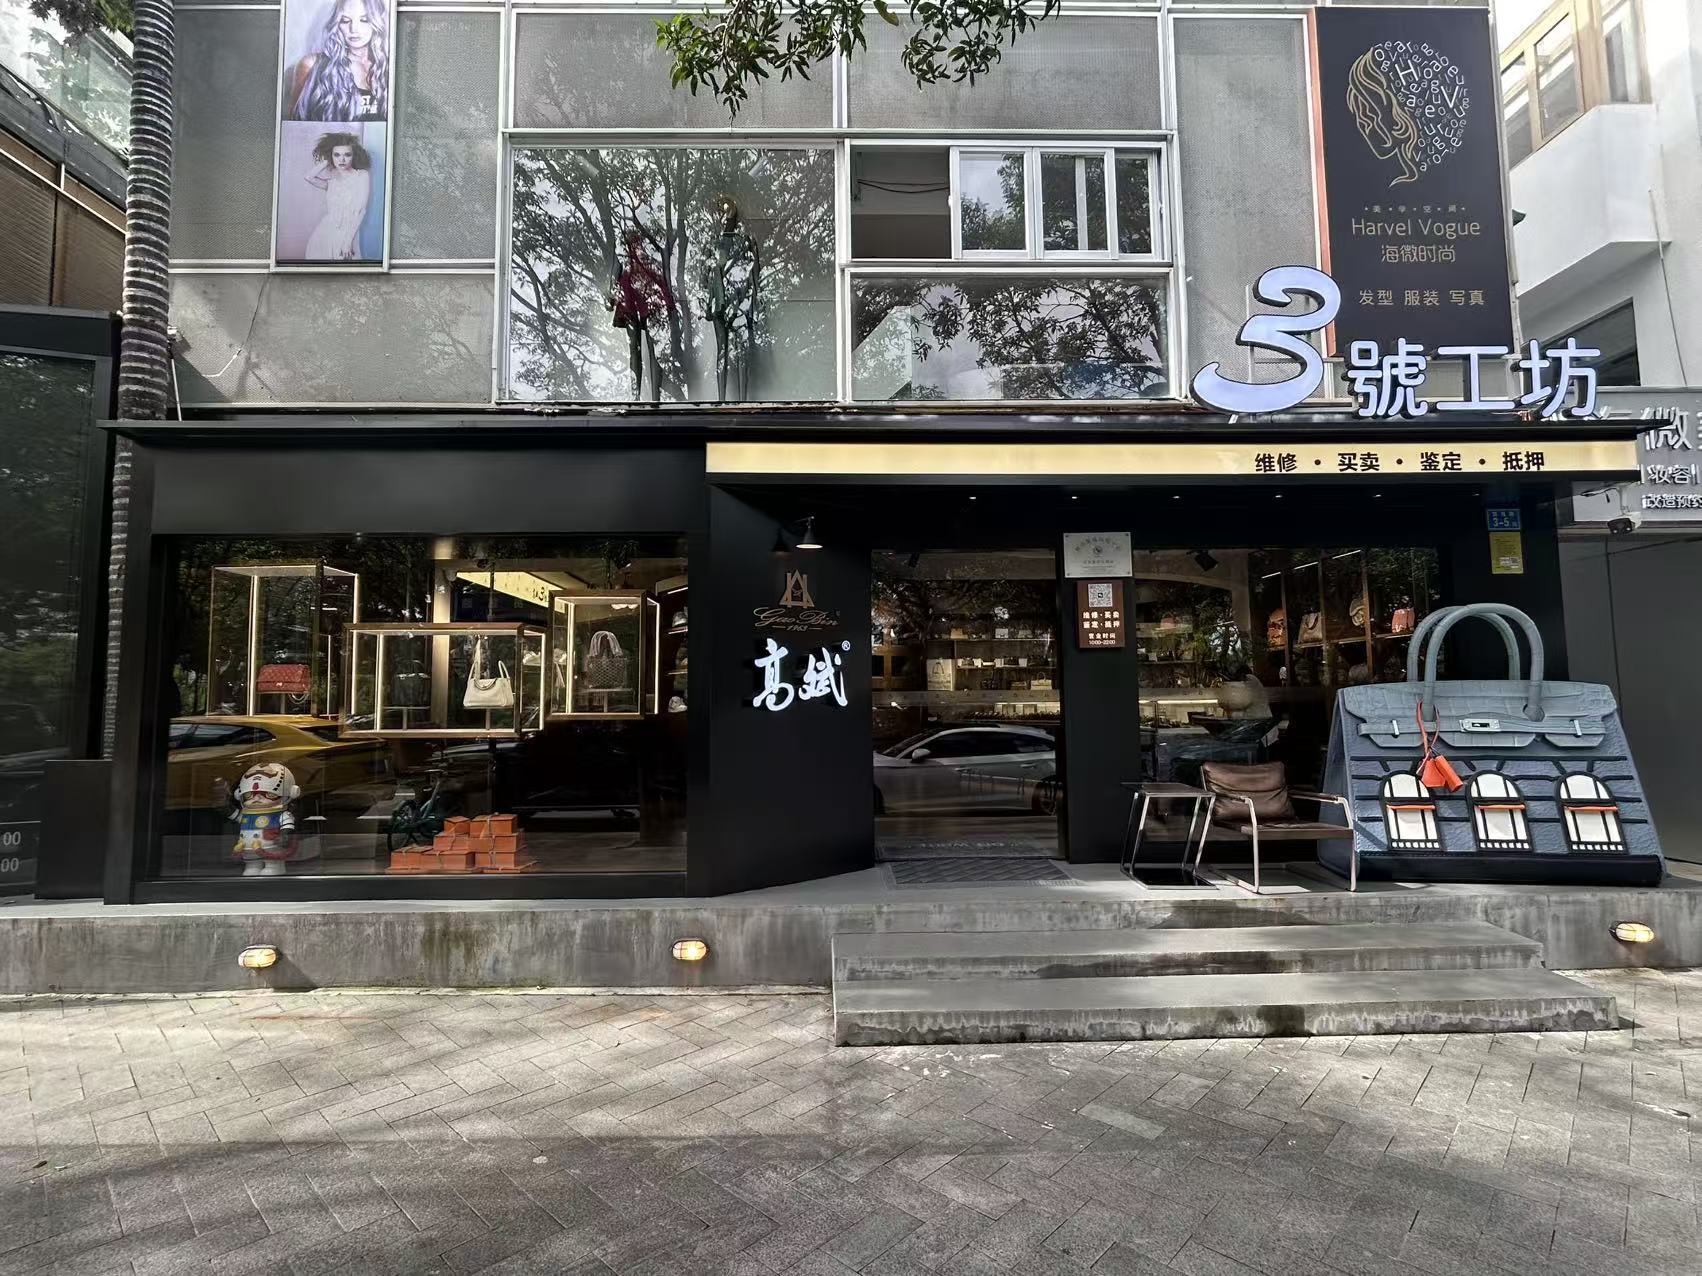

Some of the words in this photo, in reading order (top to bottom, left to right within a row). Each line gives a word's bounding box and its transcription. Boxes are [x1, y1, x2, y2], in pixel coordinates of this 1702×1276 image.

[1352, 218, 1411, 236] Harvel
[1418, 218, 1481, 240] Vogue
[1381, 245, 1456, 263] 海微时尚
[1359, 290, 1394, 306] 发型
[1404, 290, 1440, 306] 服装
[1449, 290, 1485, 306] 写真
